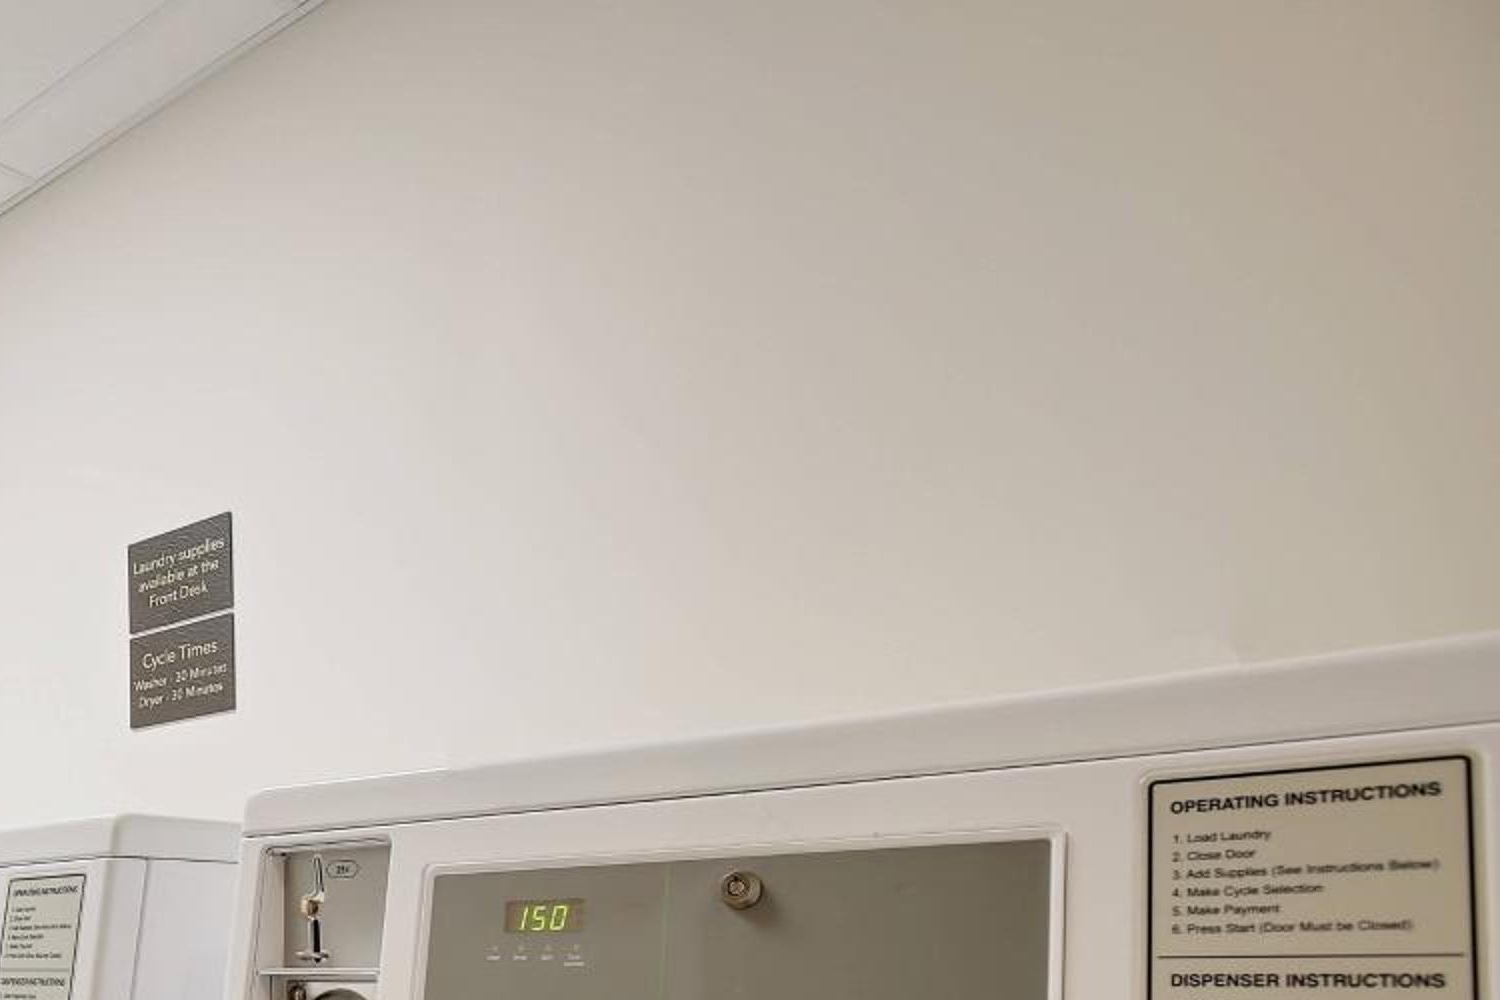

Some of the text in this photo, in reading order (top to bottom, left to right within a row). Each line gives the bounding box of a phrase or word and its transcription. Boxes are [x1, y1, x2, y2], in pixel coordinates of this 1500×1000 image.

[133, 538, 224, 575] Laundry supplies
[201, 558, 219, 573] the
[149, 579, 209, 608] Front Desk
[143, 641, 218, 671] Cycle Times
[1170, 781, 1442, 814] OPERATING INSTRUCTIONS
[1187, 832, 1218, 843] Load
[1220, 830, 1271, 842] Laundry
[1187, 851, 1221, 861] Close
[1225, 849, 1256, 859] Door
[1187, 868, 1211, 879] Add
[1214, 867, 1267, 879] Supplies
[1306, 863, 1384, 874] Instructions
[1187, 887, 1220, 897] Make
[1224, 885, 1259, 898] Cycle
[1262, 884, 1324, 895] Selection
[519, 904, 568, 931] 150
[1187, 905, 1220, 915] Make
[1224, 904, 1280, 917] Payment
[1187, 923, 1222, 934] Press
[1225, 923, 1255, 933] Start
[1299, 920, 1332, 932] Must
[1337, 921, 1353, 931] be
[1171, 973, 1445, 989] DISPENSER INSTRUCTIONS
